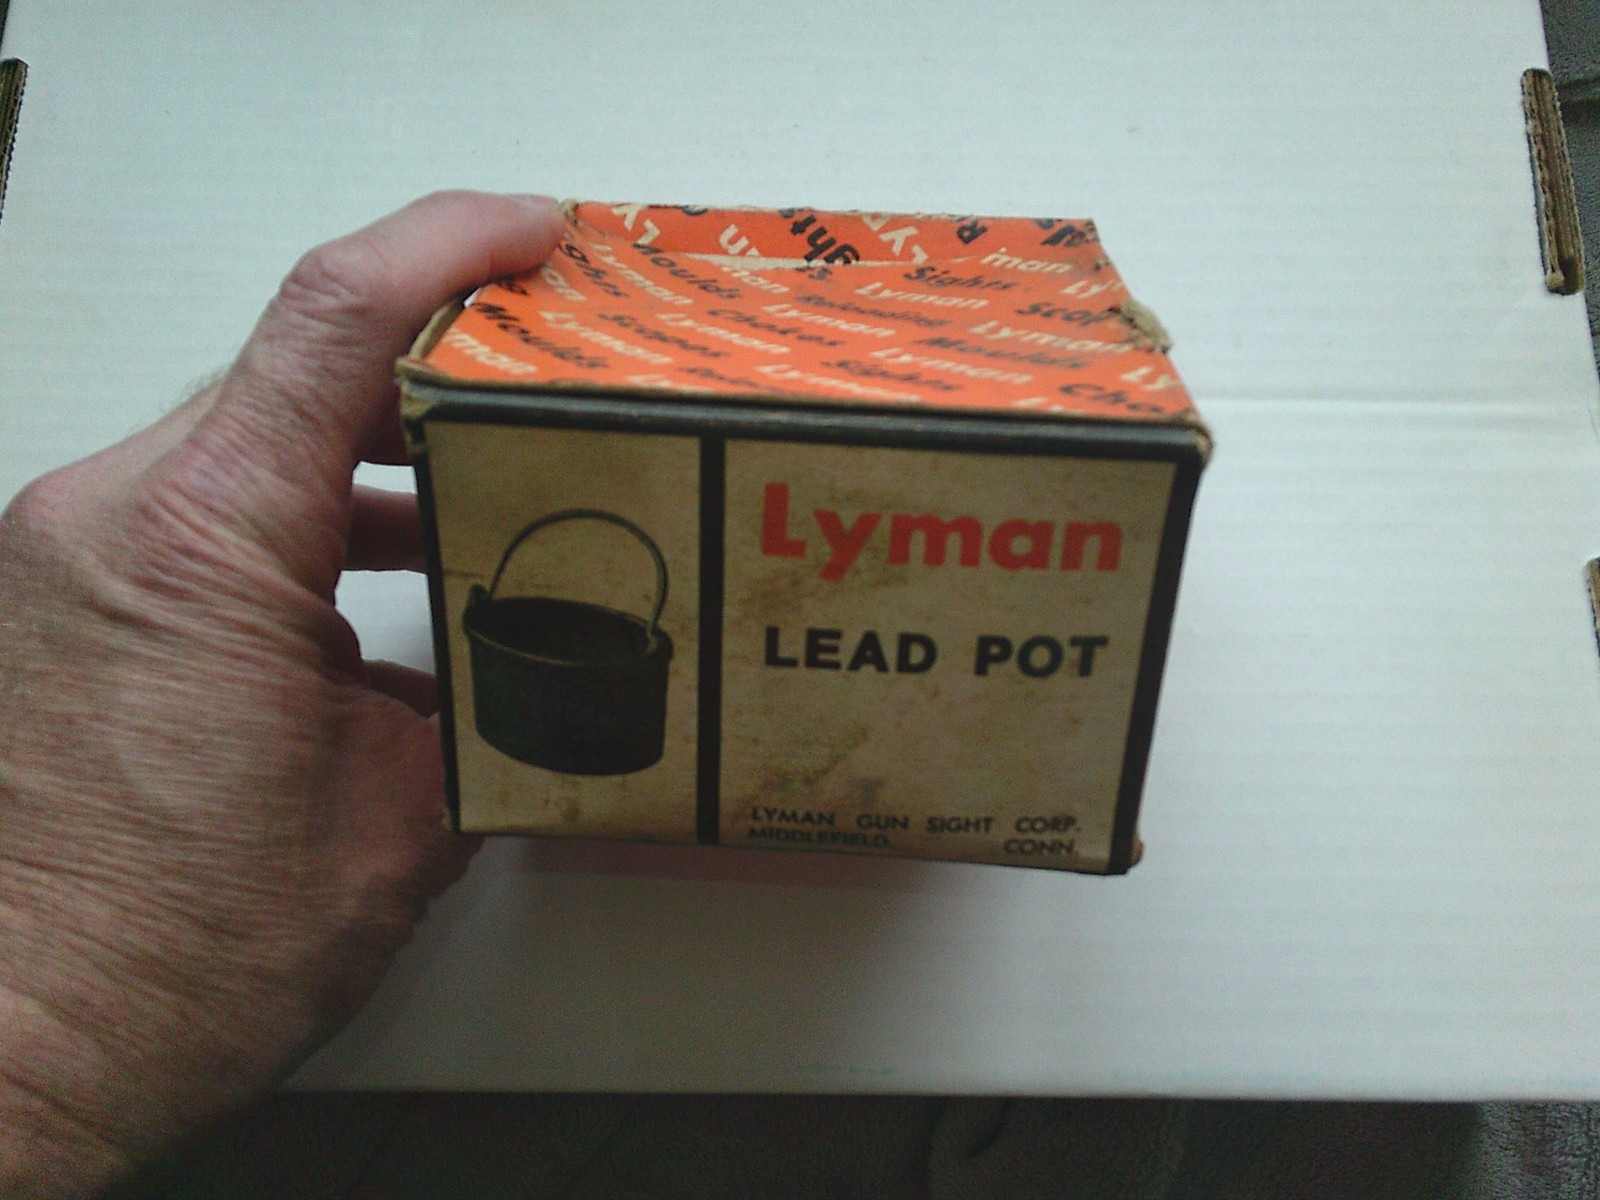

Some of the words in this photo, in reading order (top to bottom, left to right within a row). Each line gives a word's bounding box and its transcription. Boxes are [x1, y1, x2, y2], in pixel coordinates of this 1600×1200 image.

[589, 242, 695, 306] Lyman
[855, 281, 990, 310] Lyman
[903, 264, 1024, 291] Sights
[539, 309, 676, 367] Lyman
[656, 312, 792, 355] Lyman
[760, 303, 897, 338] Lyman
[968, 310, 1136, 354] Lyman
[869, 347, 1035, 386] Lyman
[761, 482, 1124, 582] Lyman
[764, 626, 938, 674] LEAD
[974, 634, 1109, 679] POT
[751, 805, 836, 828] LYMAN
[856, 813, 909, 830] GUN
[926, 816, 994, 833] SIGHT
[1014, 815, 1081, 834] CORP.
